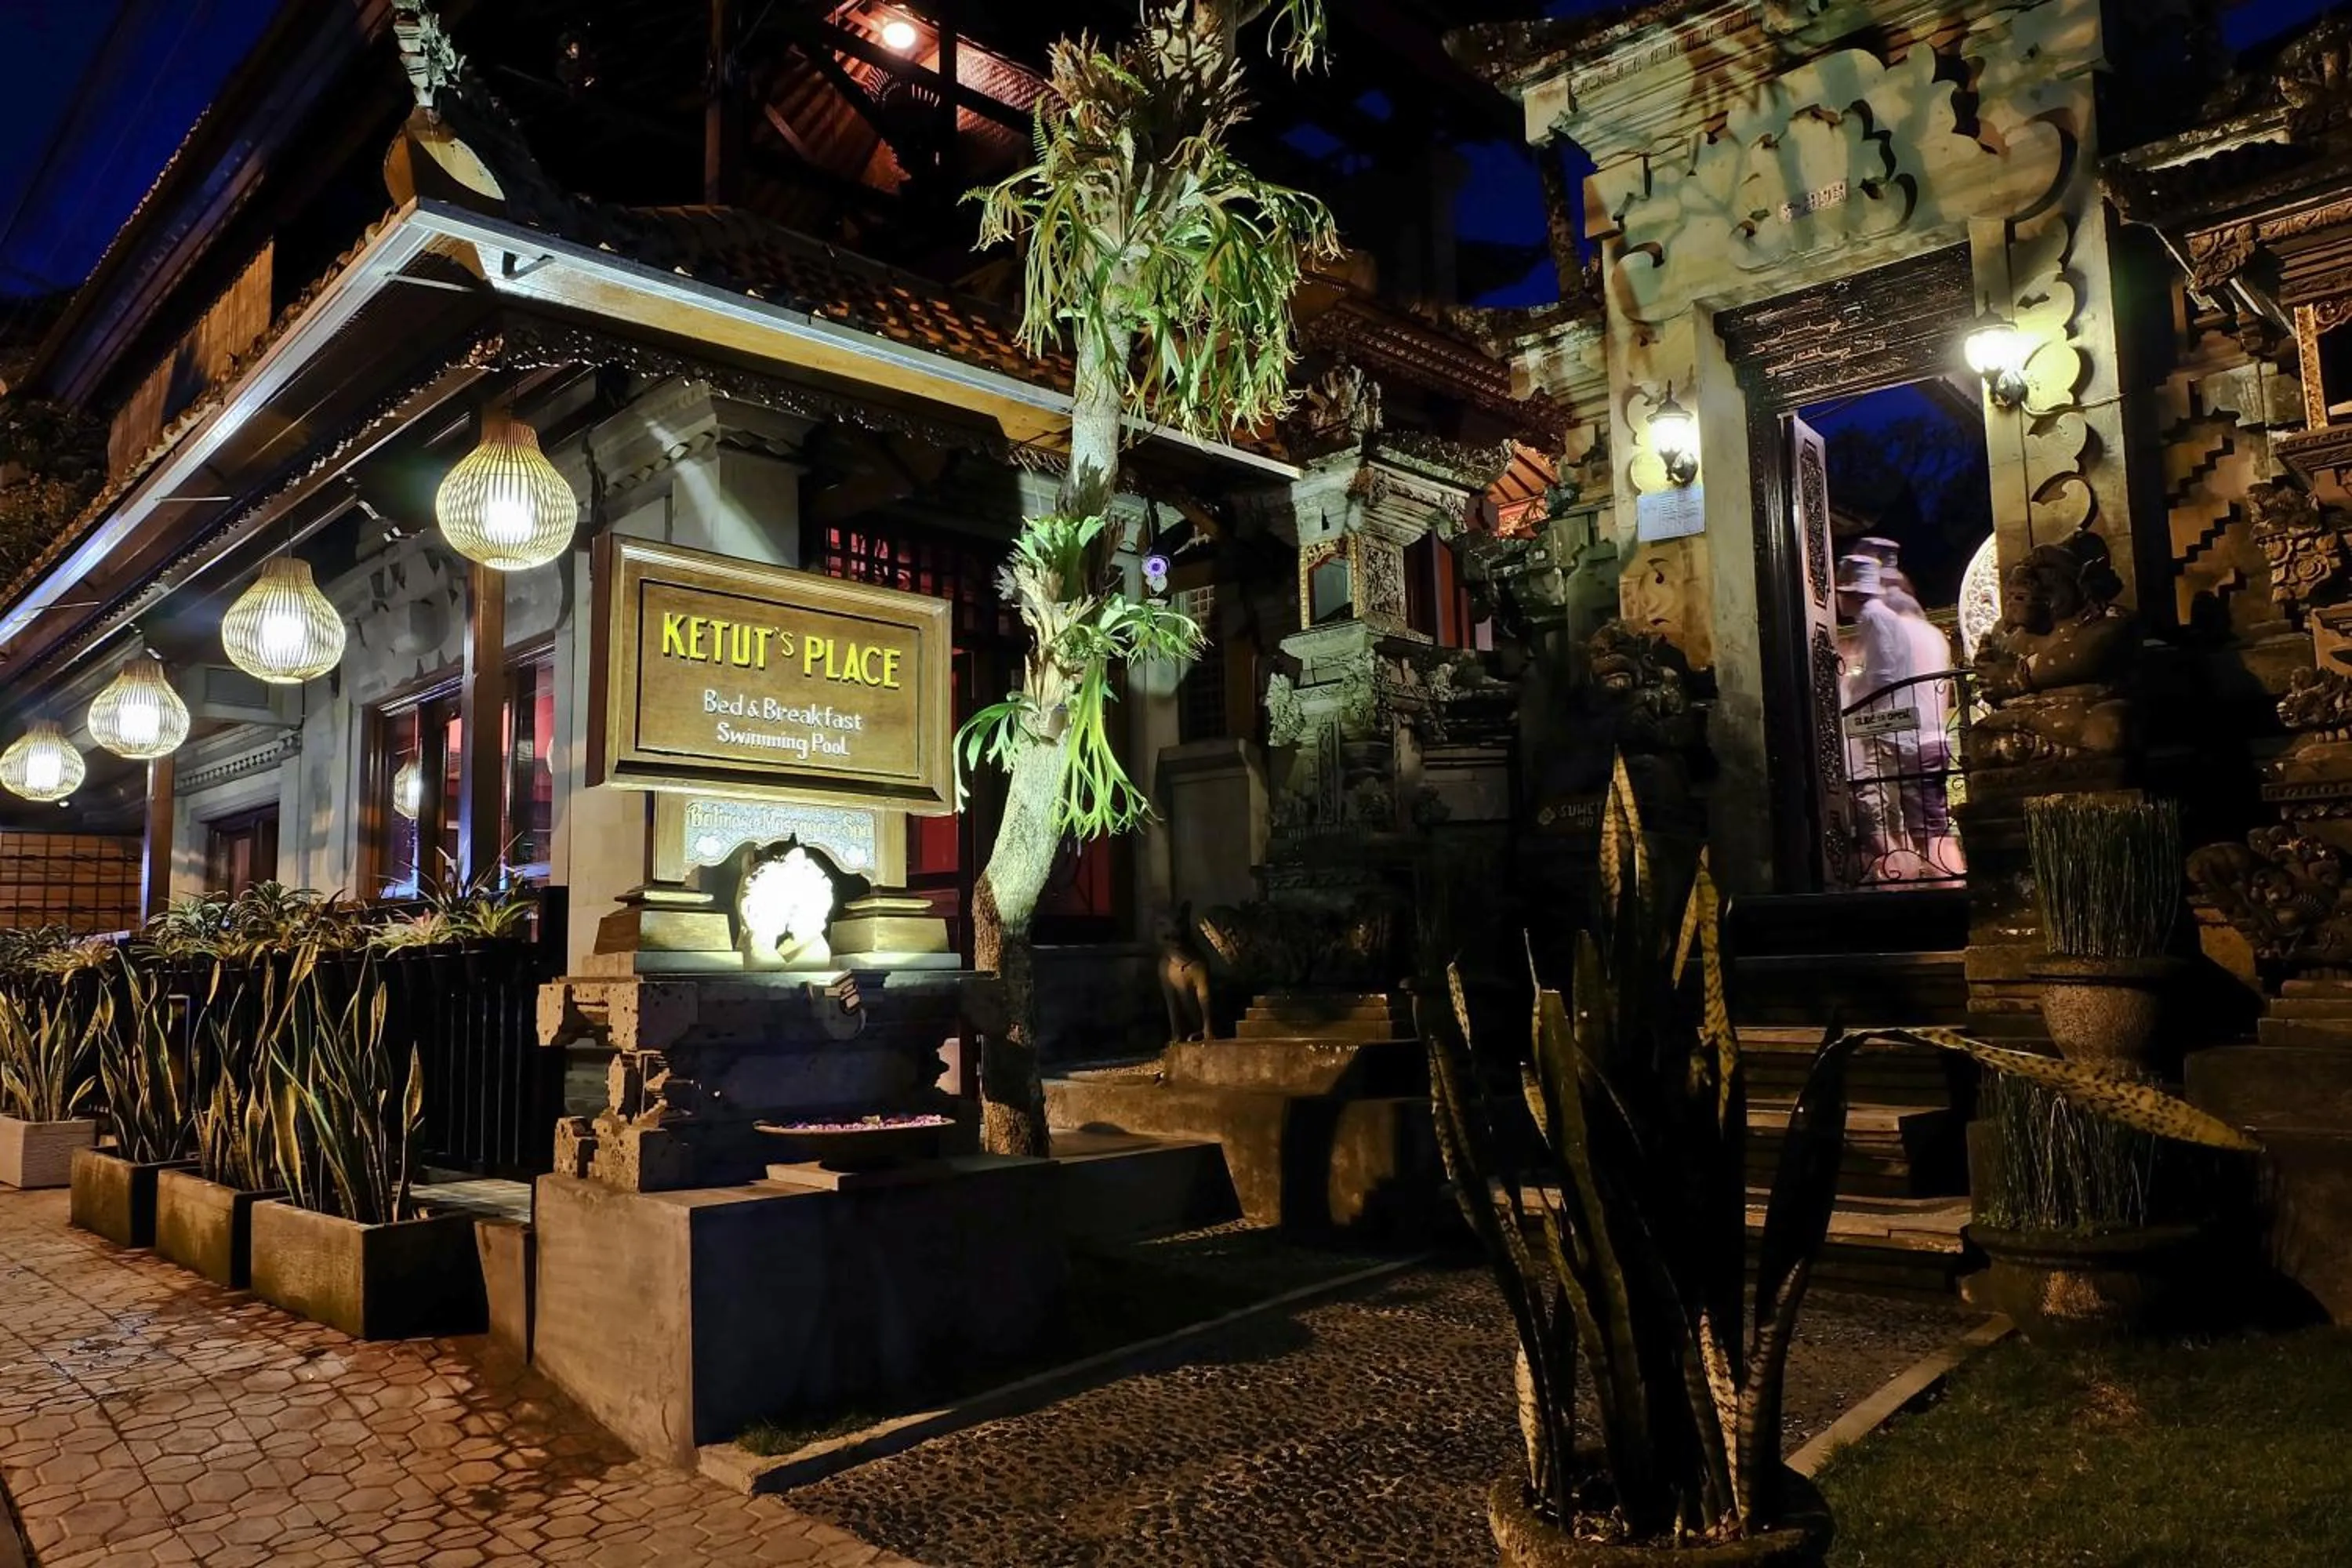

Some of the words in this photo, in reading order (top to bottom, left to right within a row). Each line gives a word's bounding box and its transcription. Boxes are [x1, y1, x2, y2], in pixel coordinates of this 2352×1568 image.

[803, 635, 902, 690] PLACE
[705, 689, 744, 717] Bed
[746, 700, 760, 718] &
[763, 697, 863, 731] Breakfast
[717, 721, 809, 760] Swimming
